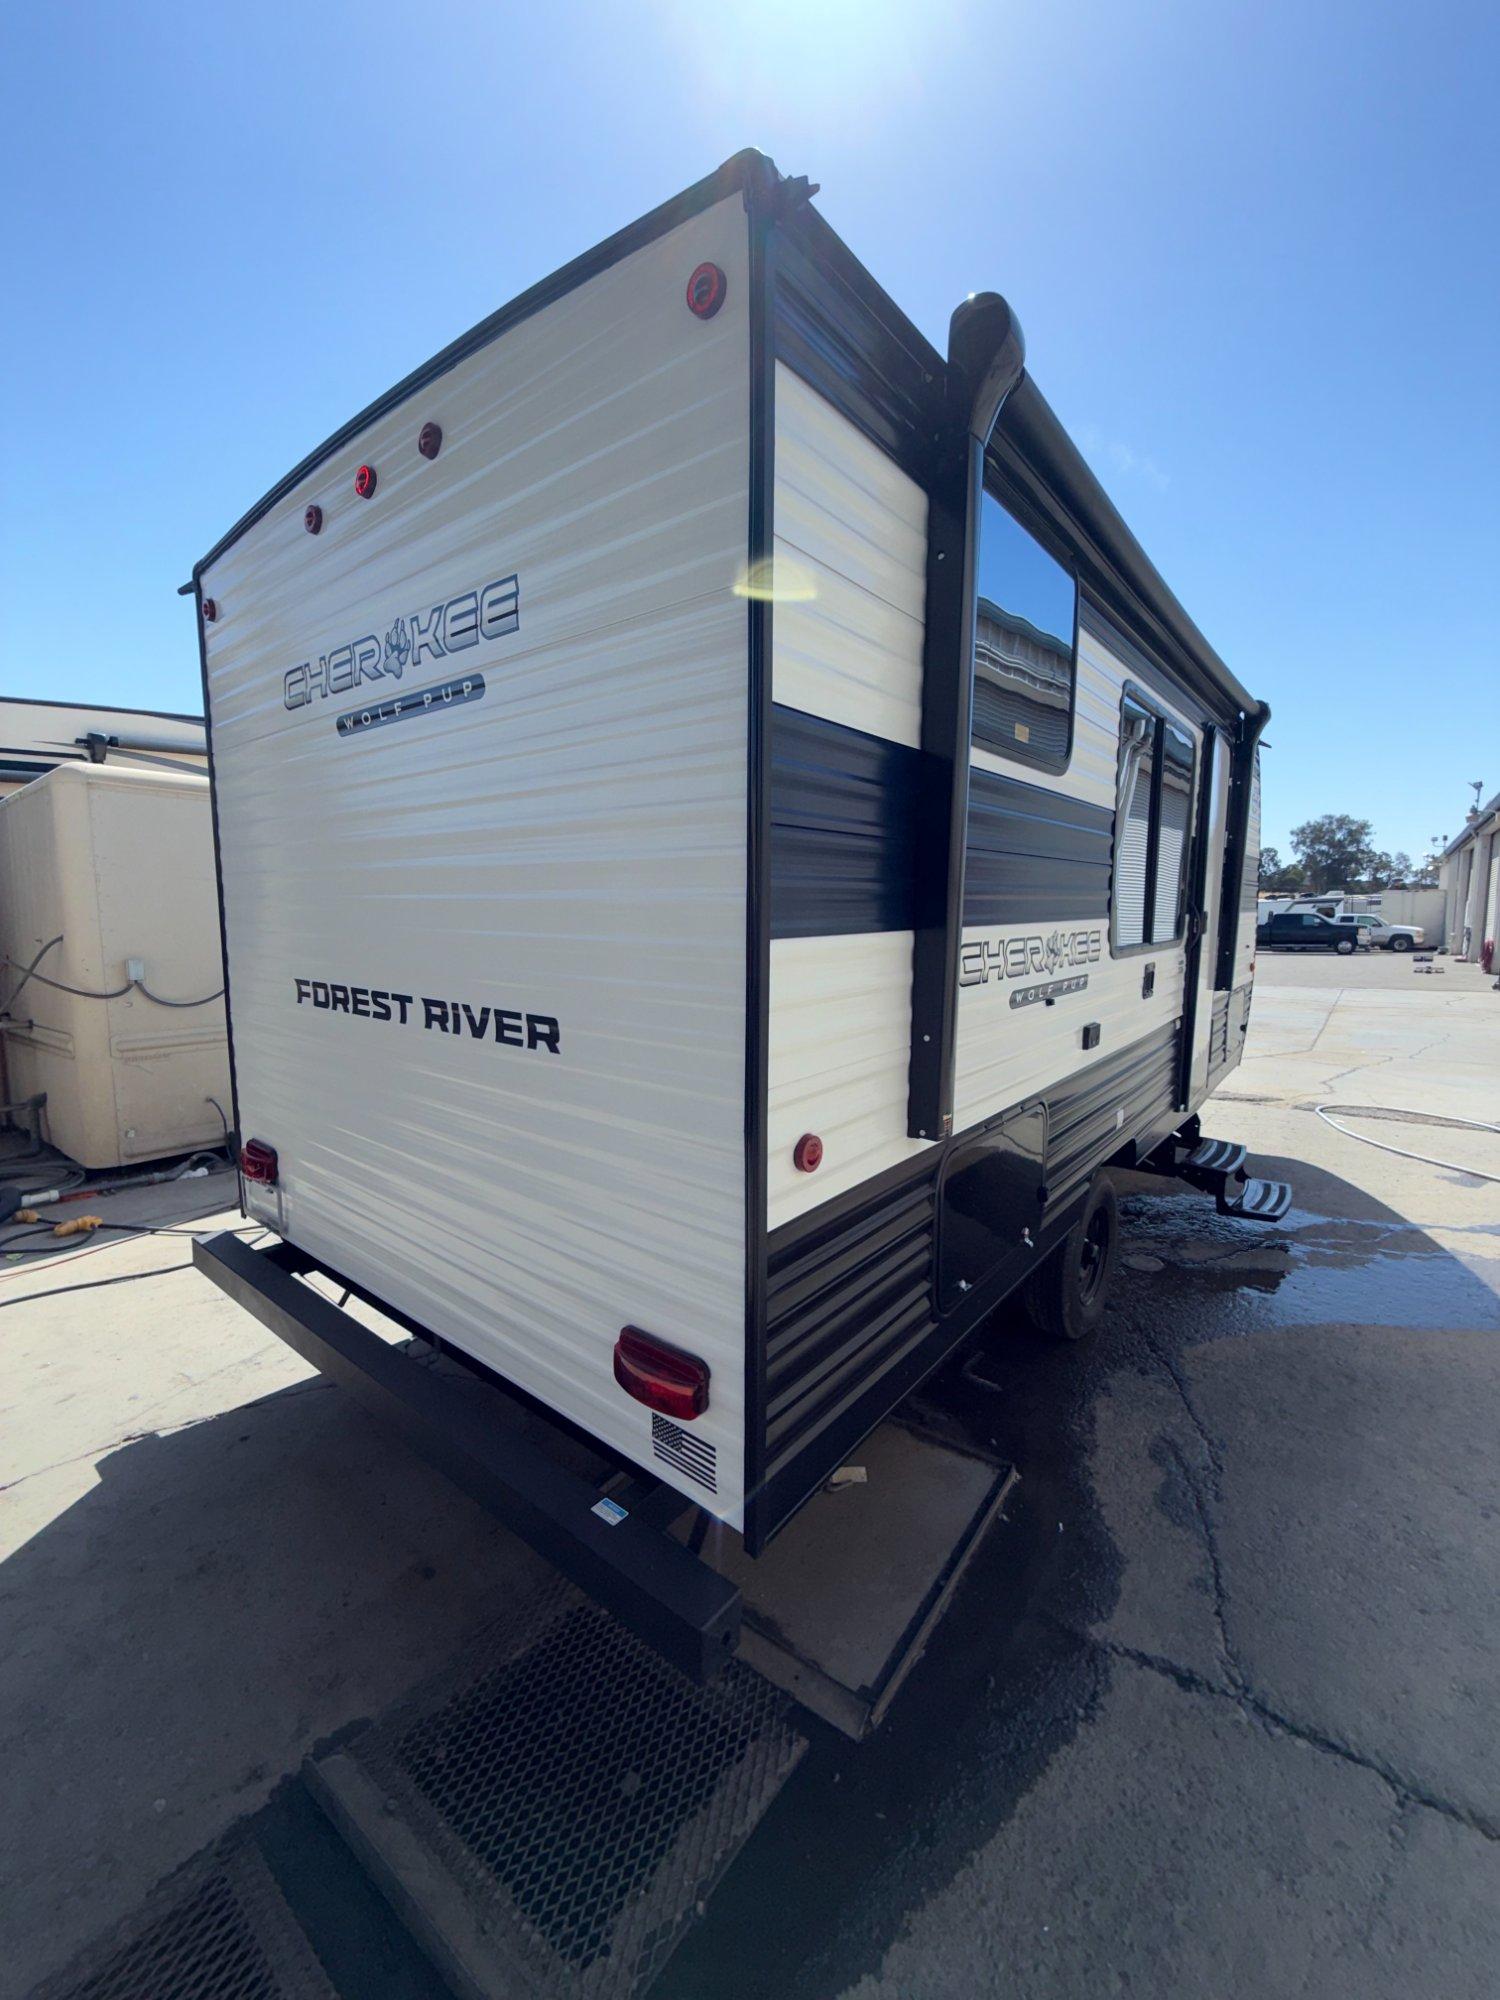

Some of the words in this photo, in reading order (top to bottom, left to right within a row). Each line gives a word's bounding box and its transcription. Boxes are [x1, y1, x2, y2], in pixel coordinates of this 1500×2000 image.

[343, 702, 403, 730] WOLF
[423, 681, 473, 708] PUP
[1015, 984, 1054, 1004] WOLF
[1062, 977, 1085, 992] PUP
[293, 978, 414, 1025] FOREST
[421, 997, 561, 1055] RIVER
